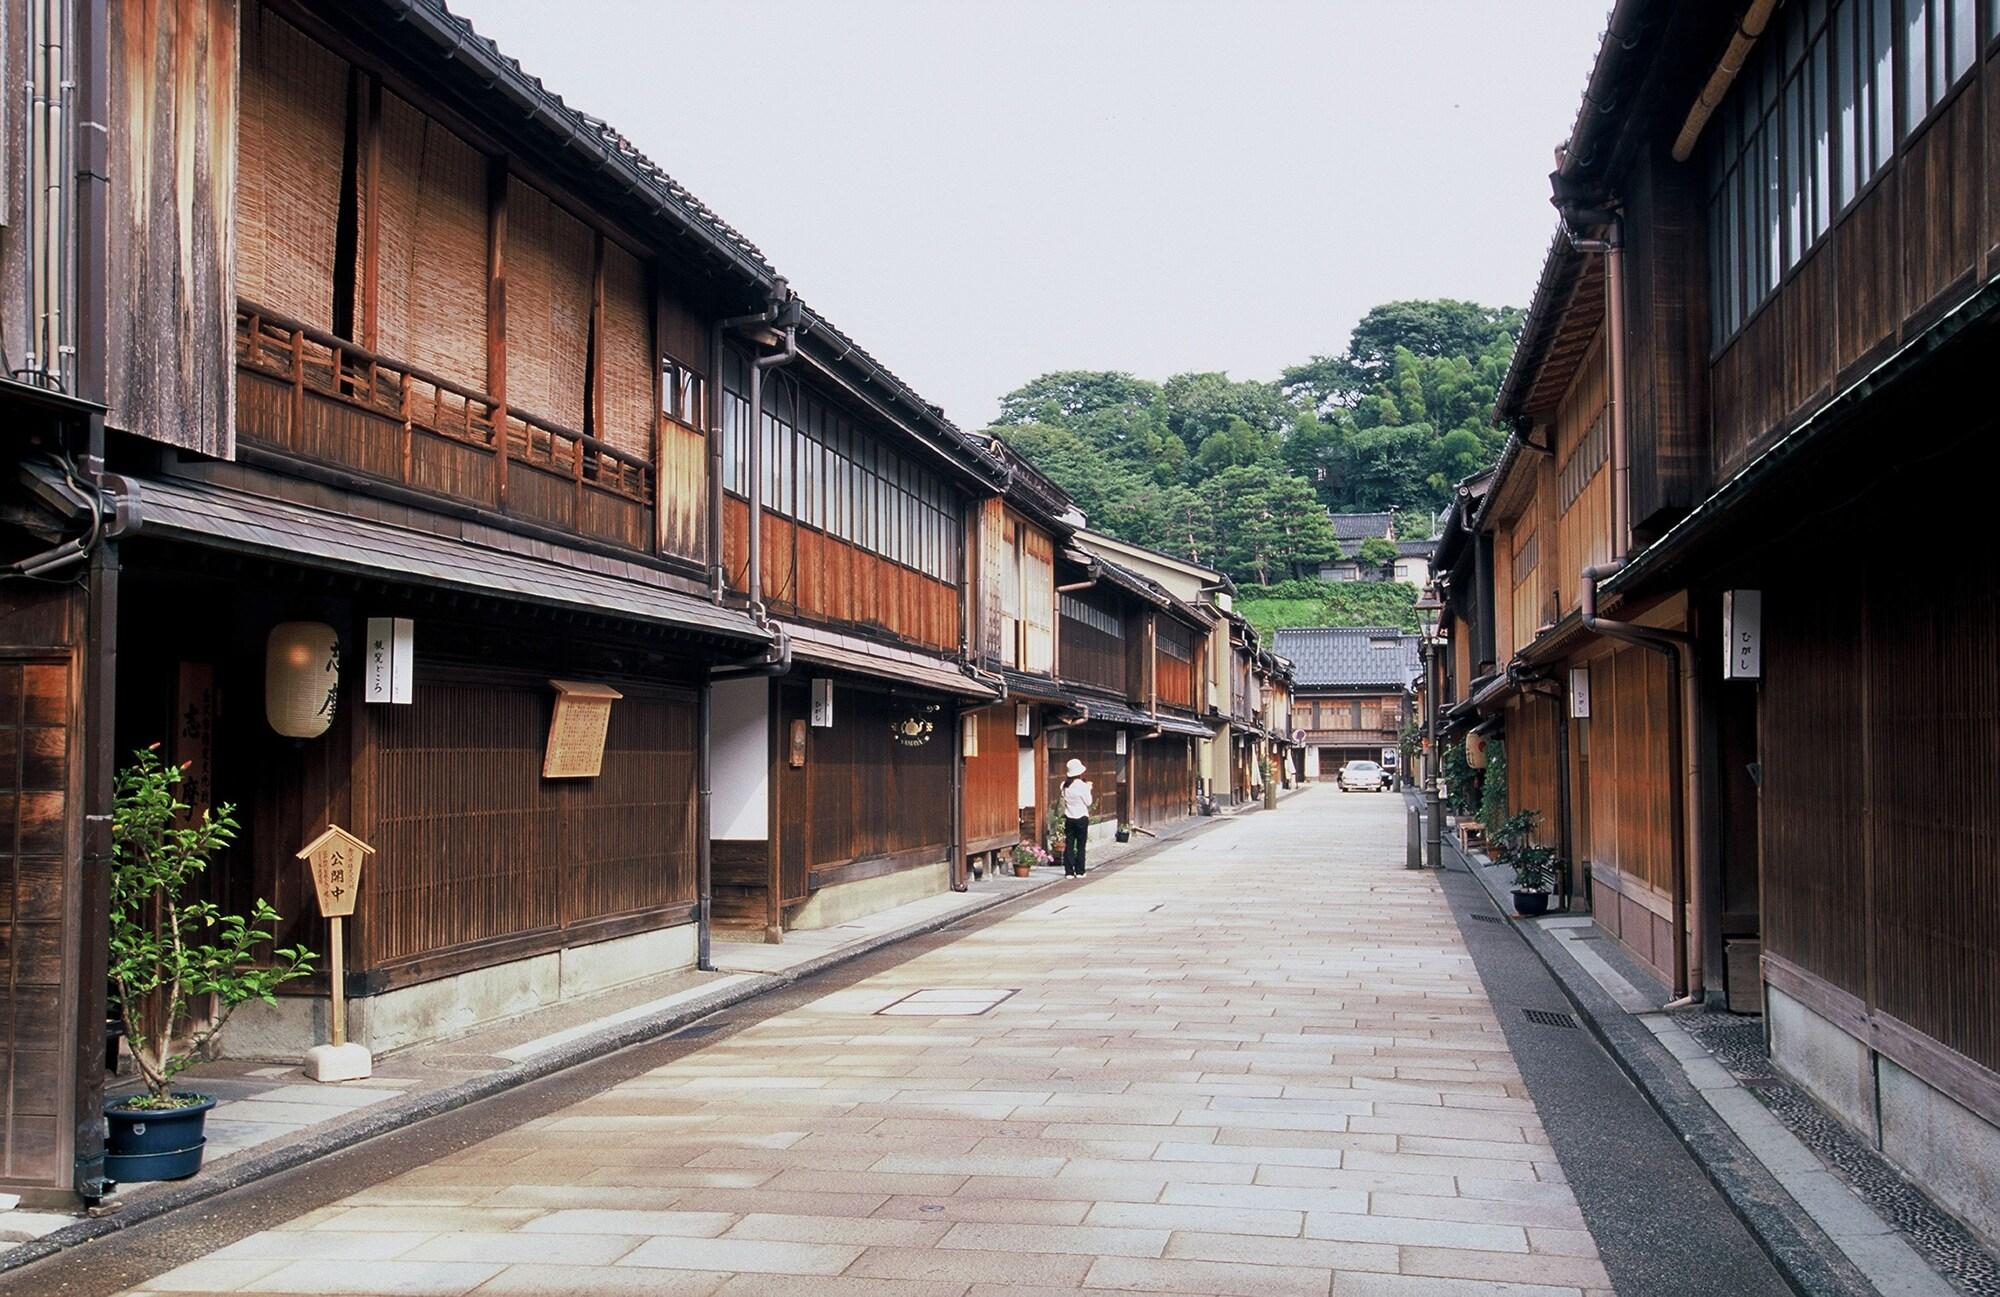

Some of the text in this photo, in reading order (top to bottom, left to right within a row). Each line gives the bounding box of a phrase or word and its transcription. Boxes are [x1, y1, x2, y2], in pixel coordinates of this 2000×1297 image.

[1741, 631, 1752, 670] ひがし
[330, 851, 345, 903] 公開中
